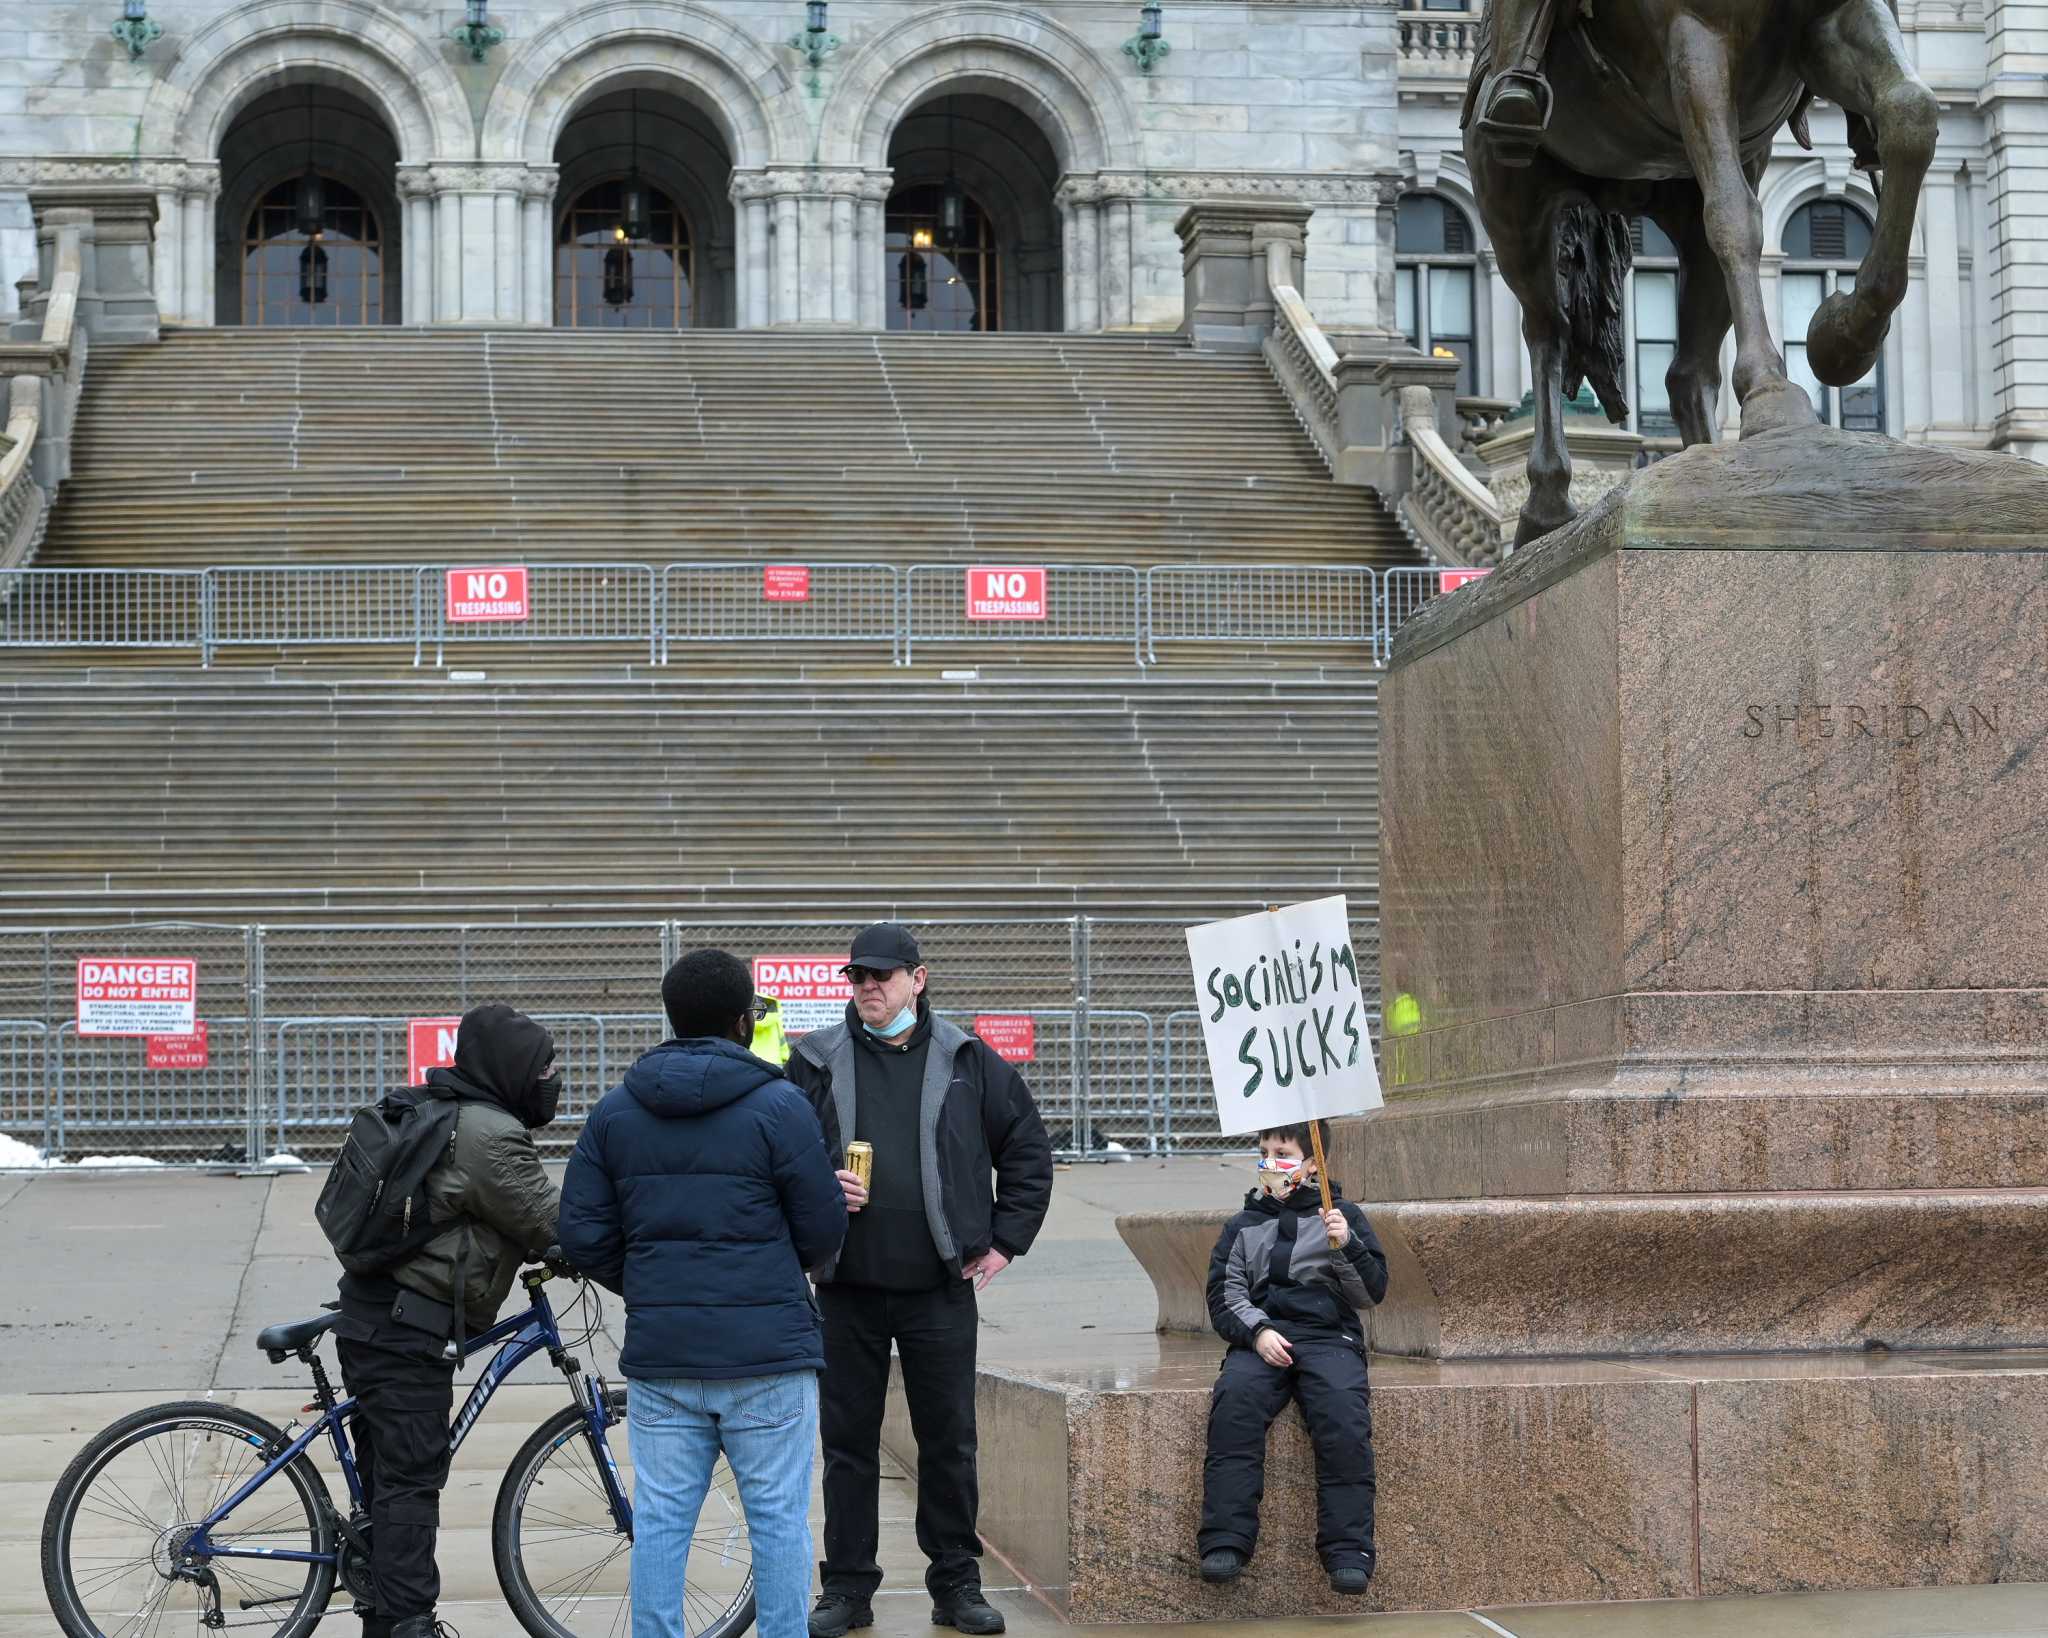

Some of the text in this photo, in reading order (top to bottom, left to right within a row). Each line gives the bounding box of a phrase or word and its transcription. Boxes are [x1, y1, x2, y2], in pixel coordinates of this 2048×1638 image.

[467, 573, 508, 599] NO
[987, 573, 1027, 598] NO
[454, 601, 522, 615] TRESPASSING
[974, 601, 1040, 614] TRESPASSING
[1744, 705, 2000, 738] SHERIDAN
[83, 965, 189, 984] DANGER
[759, 965, 850, 983] DANGE
[83, 987, 189, 998] DO NOT ENTER
[760, 986, 780, 996] DO
[783, 986, 813, 996] NOT
[152, 1054, 203, 1063] NO ENTRY
[1238, 1001, 1360, 1098] SUCKS
